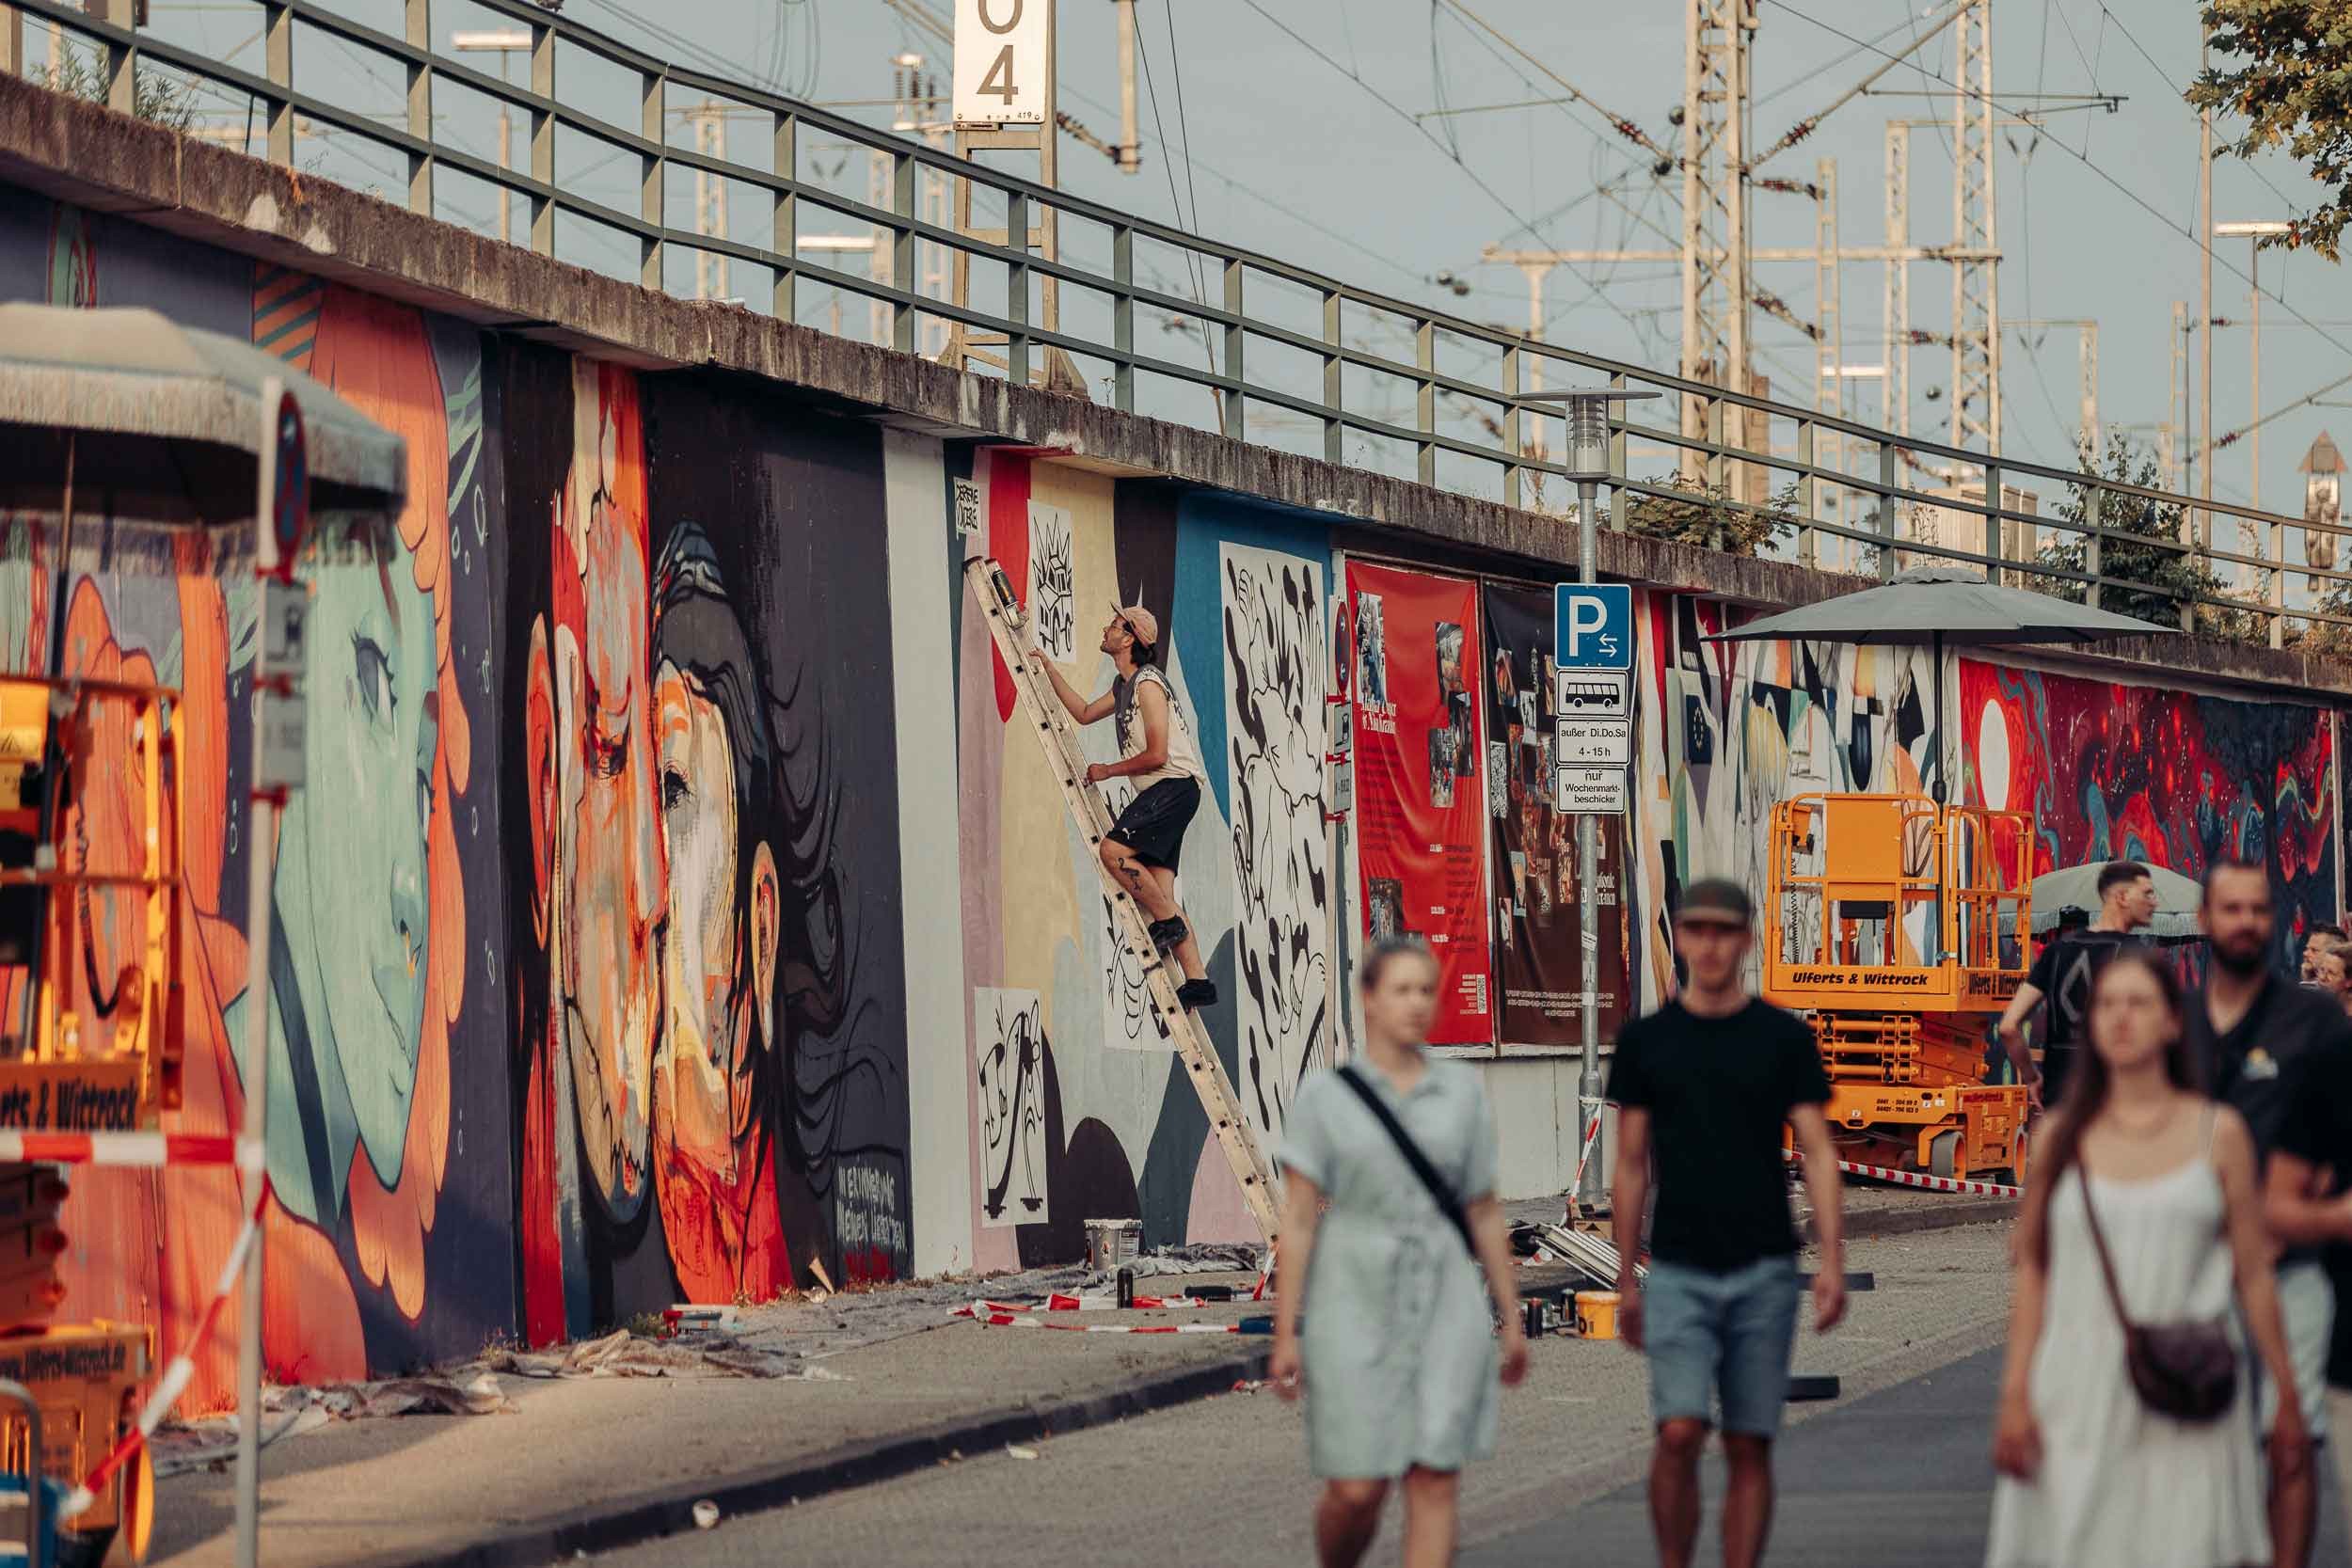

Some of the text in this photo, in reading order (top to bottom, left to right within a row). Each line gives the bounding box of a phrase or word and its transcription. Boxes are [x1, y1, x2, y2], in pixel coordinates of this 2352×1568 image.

[976, 44, 1019, 106] 4
[1568, 594, 1608, 657] P
[1561, 727, 1627, 737] außer Di.Do.Sa
[1579, 747, 1585, 756] 4
[1592, 747, 1603, 756] 15
[1605, 747, 1611, 756] h
[1584, 771, 1603, 782] nur
[1565, 783, 1621, 793] Wochenmarkt-
[1574, 794, 1616, 803] beschicker
[1791, 972, 1929, 986] Ulferts & Wittrock
